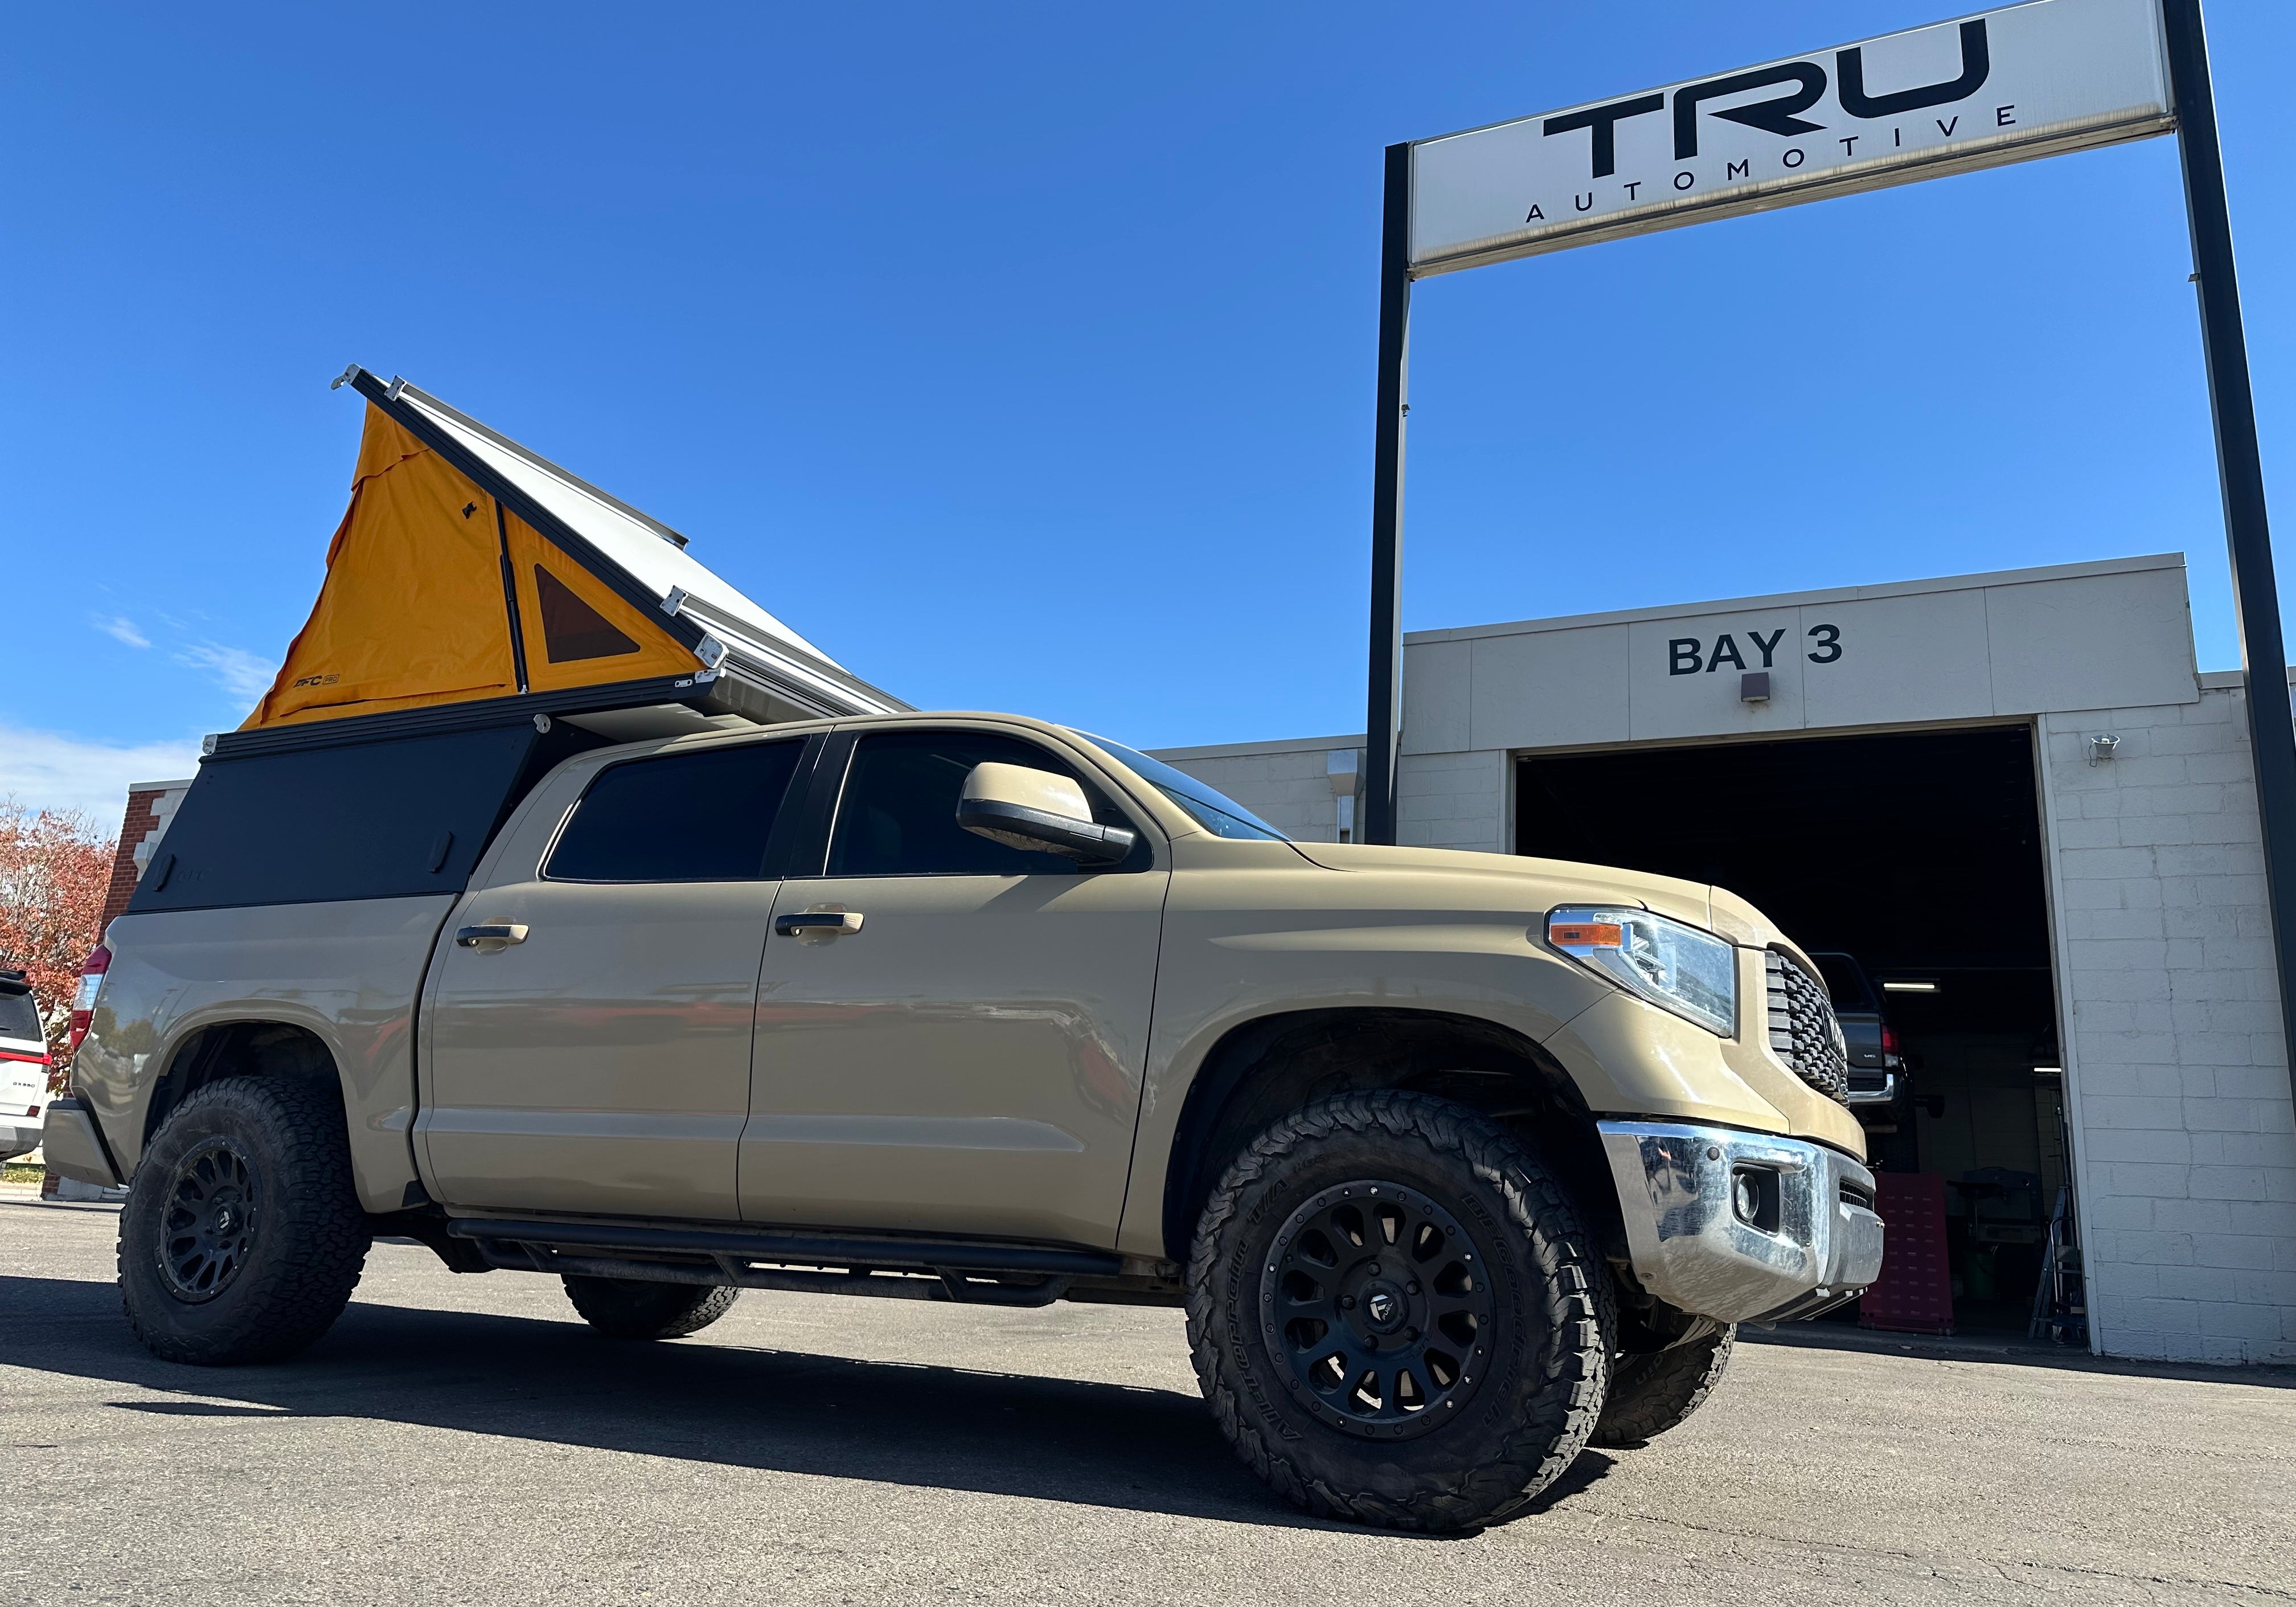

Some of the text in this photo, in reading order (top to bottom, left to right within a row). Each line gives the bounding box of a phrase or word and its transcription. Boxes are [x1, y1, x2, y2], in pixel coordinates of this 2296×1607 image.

[1543, 18, 1990, 179] TRU
[1525, 104, 2016, 223] AUTOMOTIVE
[1669, 624, 1842, 676] BAY 3
[1246, 1176, 1289, 1224] T/A
[1381, 1302, 1393, 1321] FUEL
[1461, 1194, 1526, 1428] BFGoodrich
